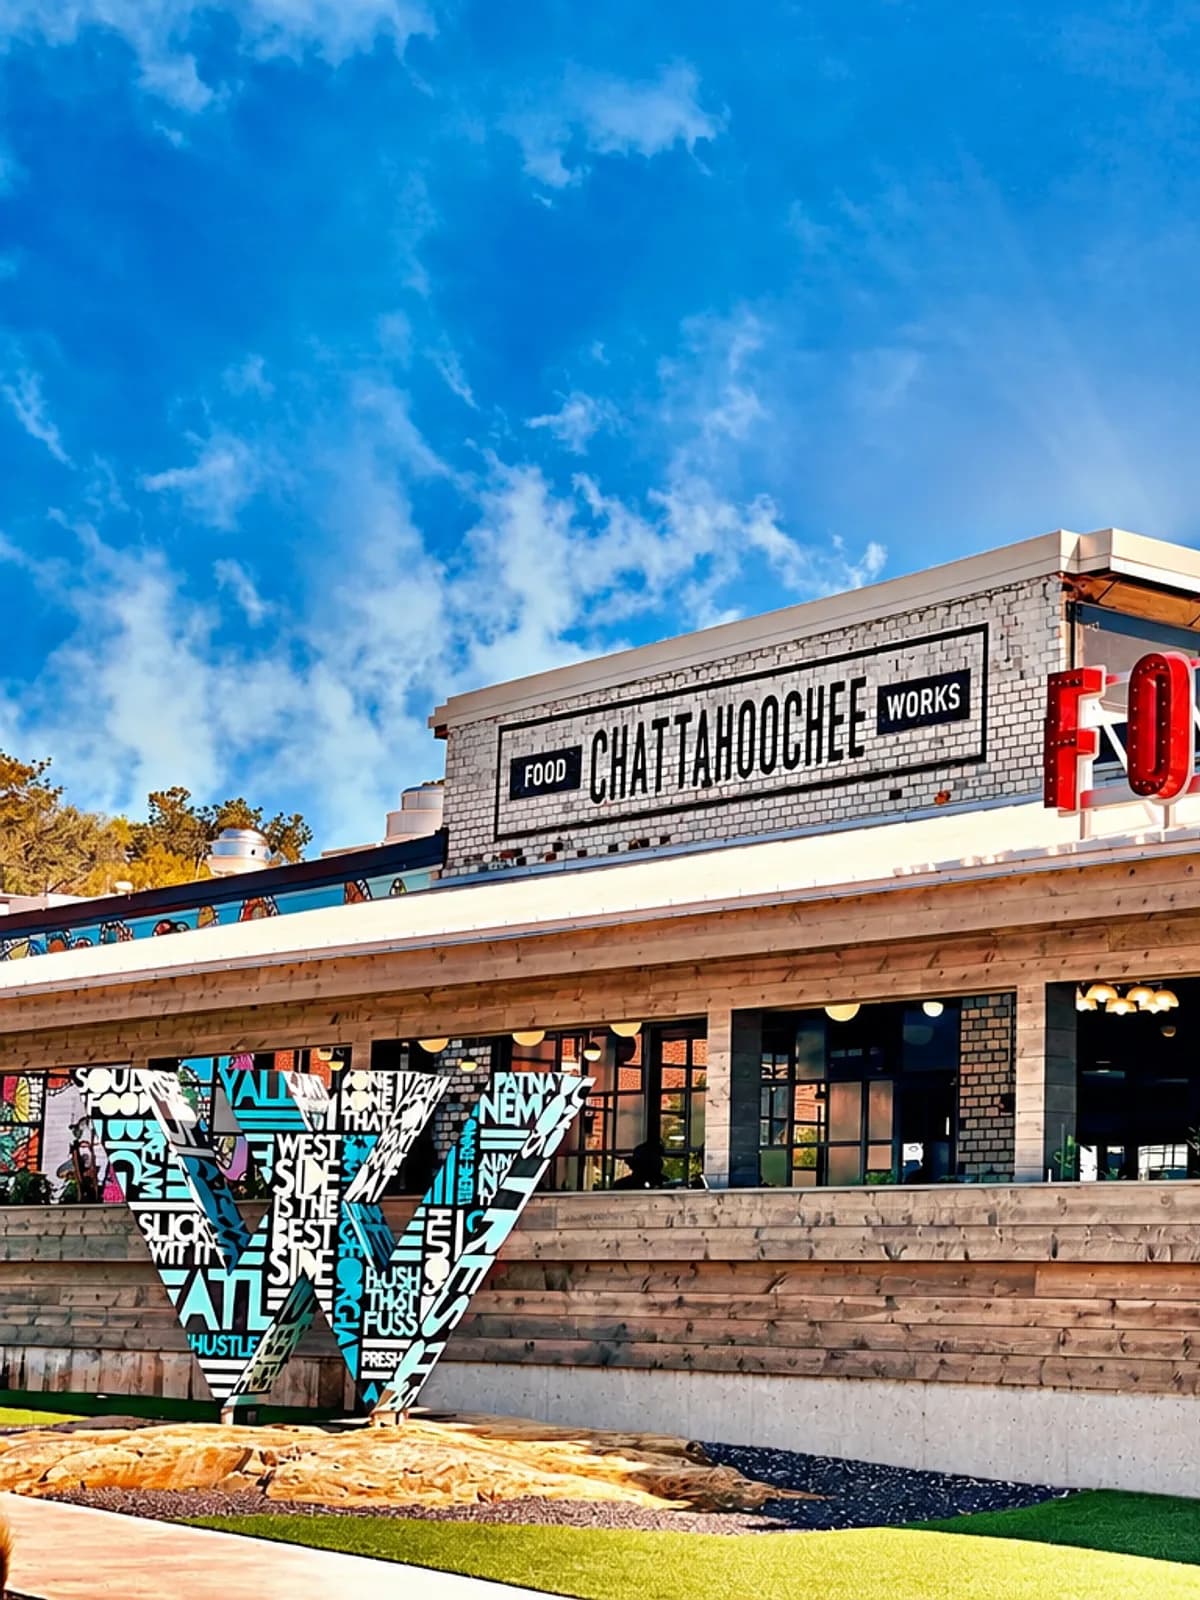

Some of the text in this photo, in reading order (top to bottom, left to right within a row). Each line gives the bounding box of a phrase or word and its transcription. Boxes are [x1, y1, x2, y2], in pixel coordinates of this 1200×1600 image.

[523, 676, 961, 804] FOOD CHATTAHOOCHEE WORKS
[76, 1067, 144, 1093] SOUL
[341, 1110, 391, 1131] THAT
[277, 1133, 342, 1160] WEST
[272, 1158, 341, 1199] SIDE
[273, 1194, 339, 1219] IS THE
[138, 1213, 210, 1243] SLICK
[272, 1218, 337, 1251] BEST
[267, 1249, 334, 1286] SIDE
[332, 1216, 365, 1347] GEORGIA
[179, 1267, 276, 1331] ATL
[362, 1311, 419, 1337] FUSS
[191, 1334, 261, 1357] HUSTLE
